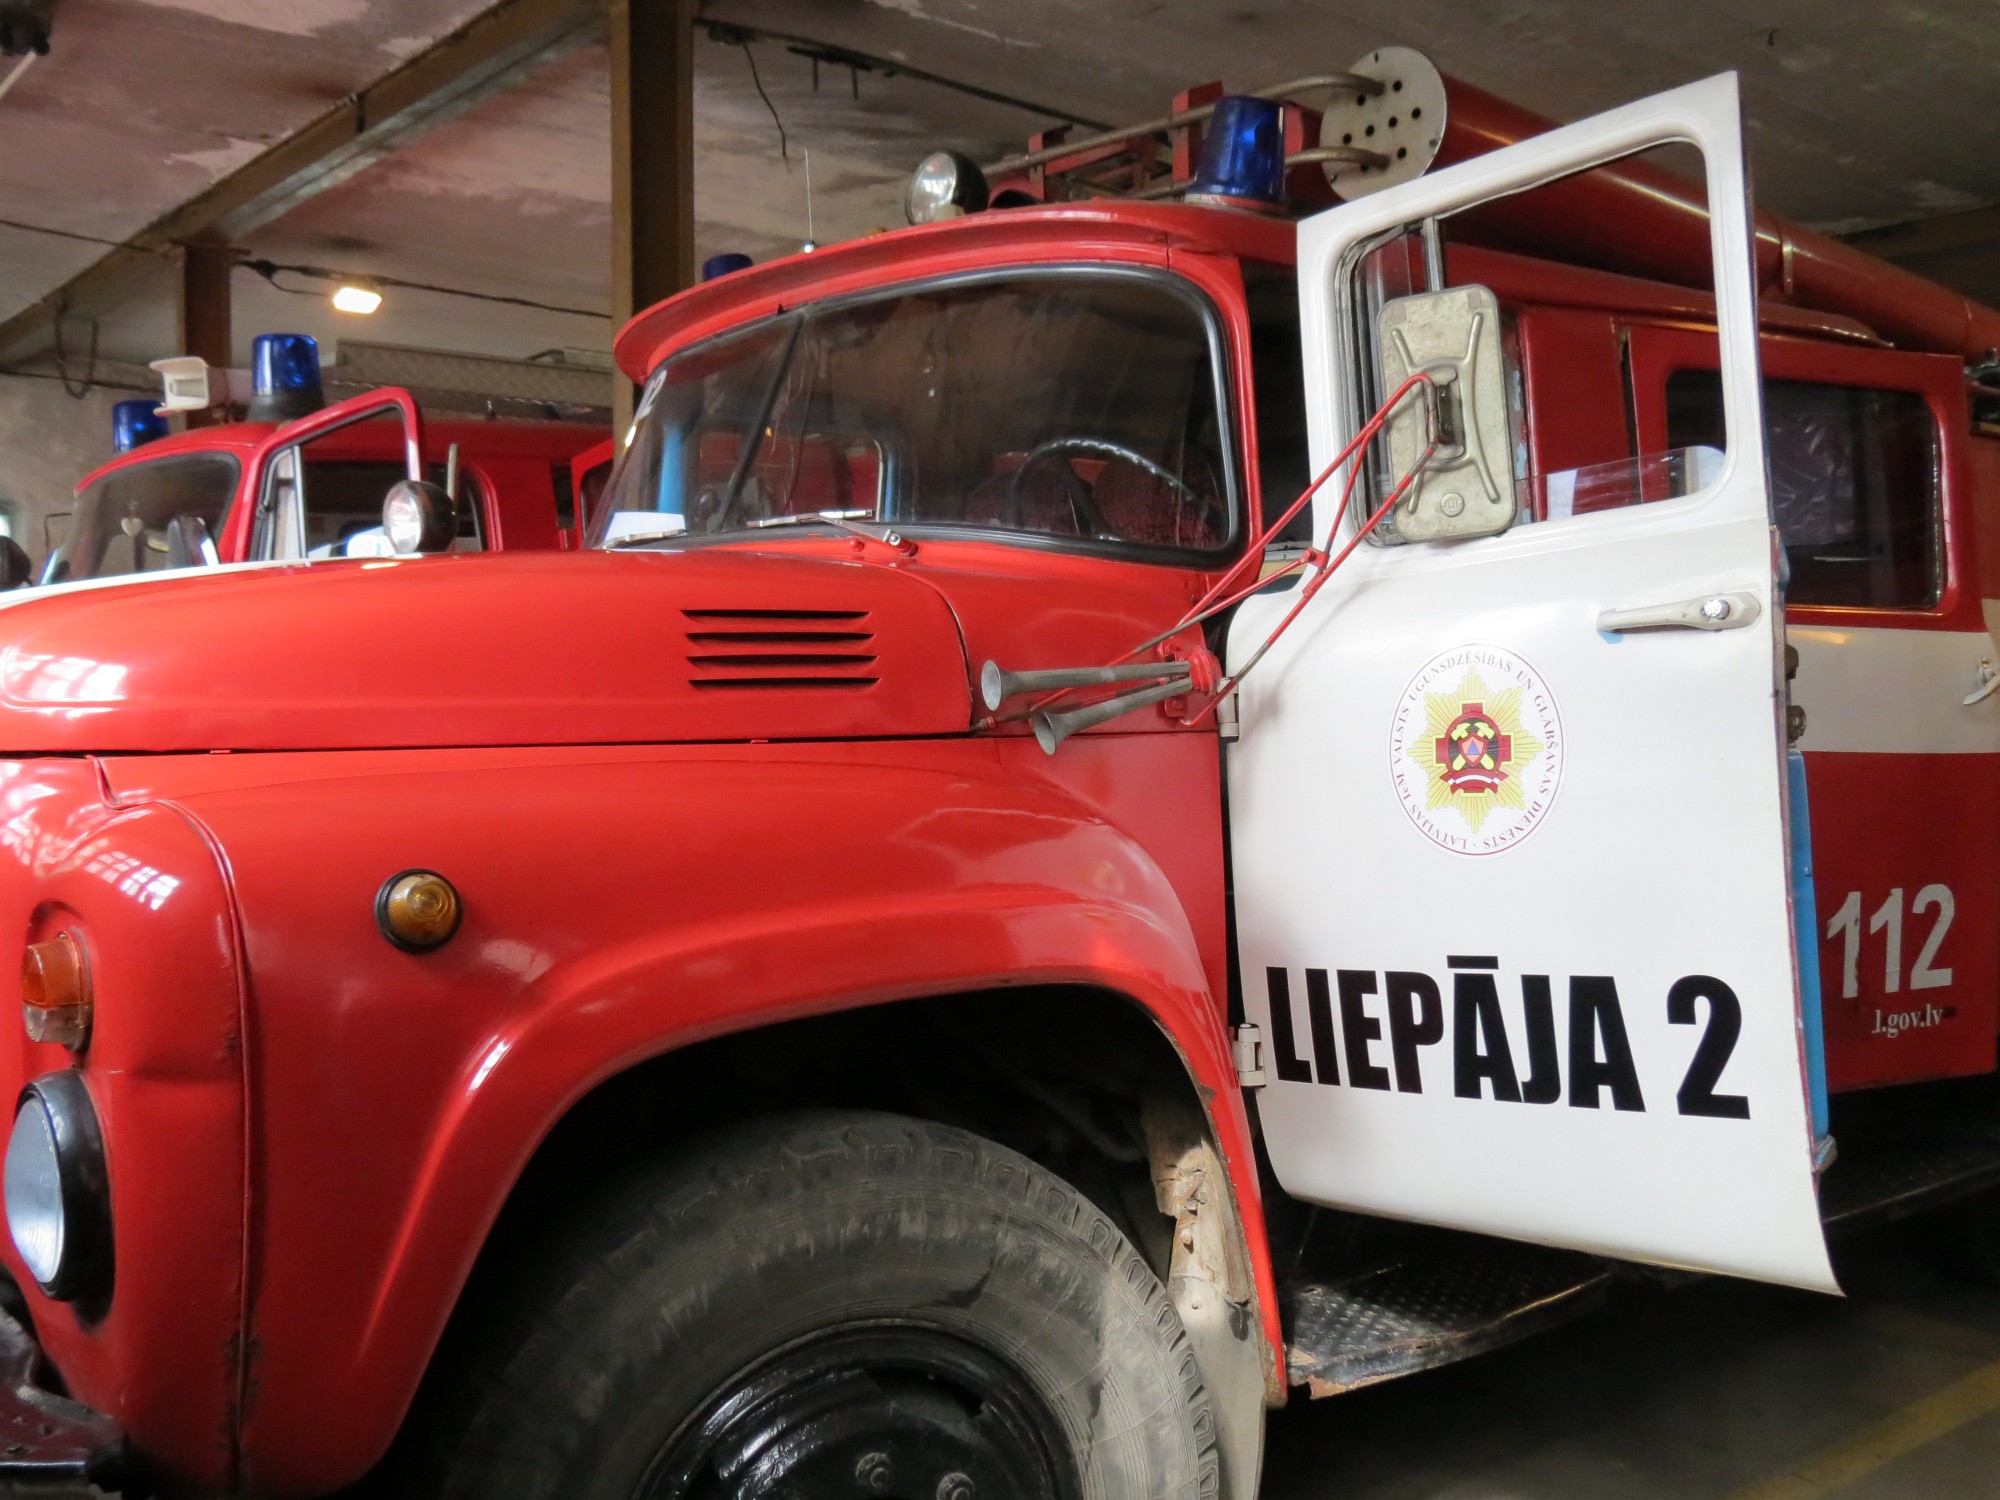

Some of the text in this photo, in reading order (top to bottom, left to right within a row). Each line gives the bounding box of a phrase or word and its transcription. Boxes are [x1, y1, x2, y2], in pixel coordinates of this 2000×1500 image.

[1517, 670, 1535, 691] UN
[1393, 705, 1409, 765] VALSTS
[1534, 694, 1559, 795] GLĀBŠANAS
[1411, 804, 1467, 850] LATVIJAS
[1484, 801, 1542, 849] DIENESTS
[1827, 883, 1955, 998] 112
[1266, 955, 1751, 1120] LIEPĀJA 2
